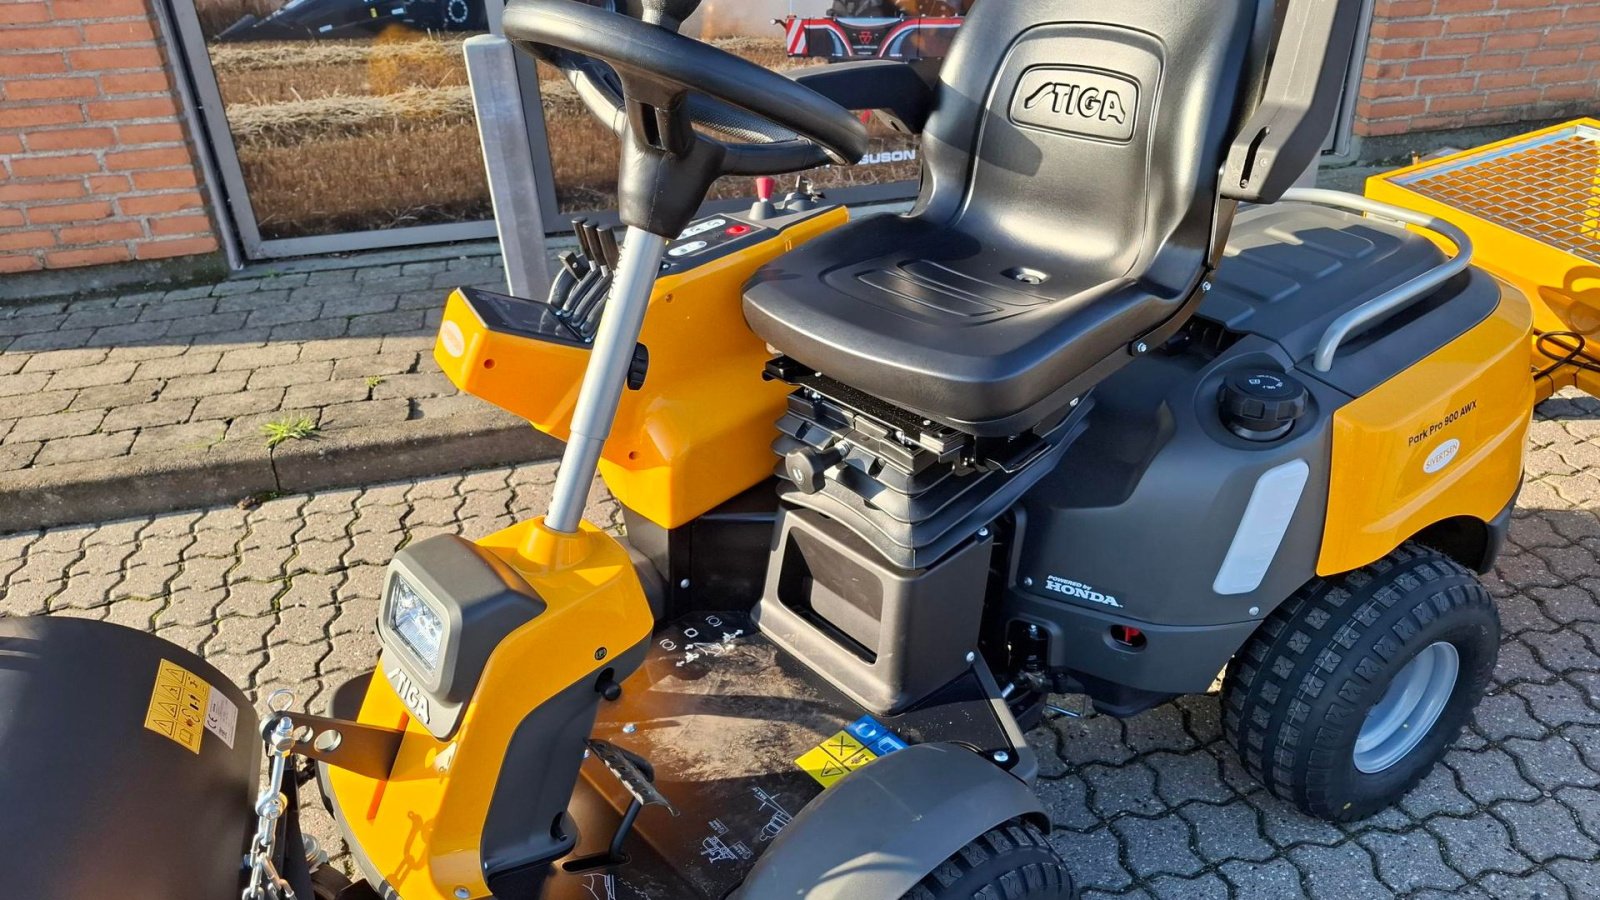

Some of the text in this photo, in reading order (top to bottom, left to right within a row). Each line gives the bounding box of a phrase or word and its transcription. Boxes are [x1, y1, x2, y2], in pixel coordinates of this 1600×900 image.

[1023, 81, 1126, 125] STIGA
[1408, 400, 1477, 447] Park Pro 900 AWX
[1045, 580, 1119, 608] HONDA
[1047, 575, 1082, 588] POWERED
[387, 667, 430, 725] STIGA
